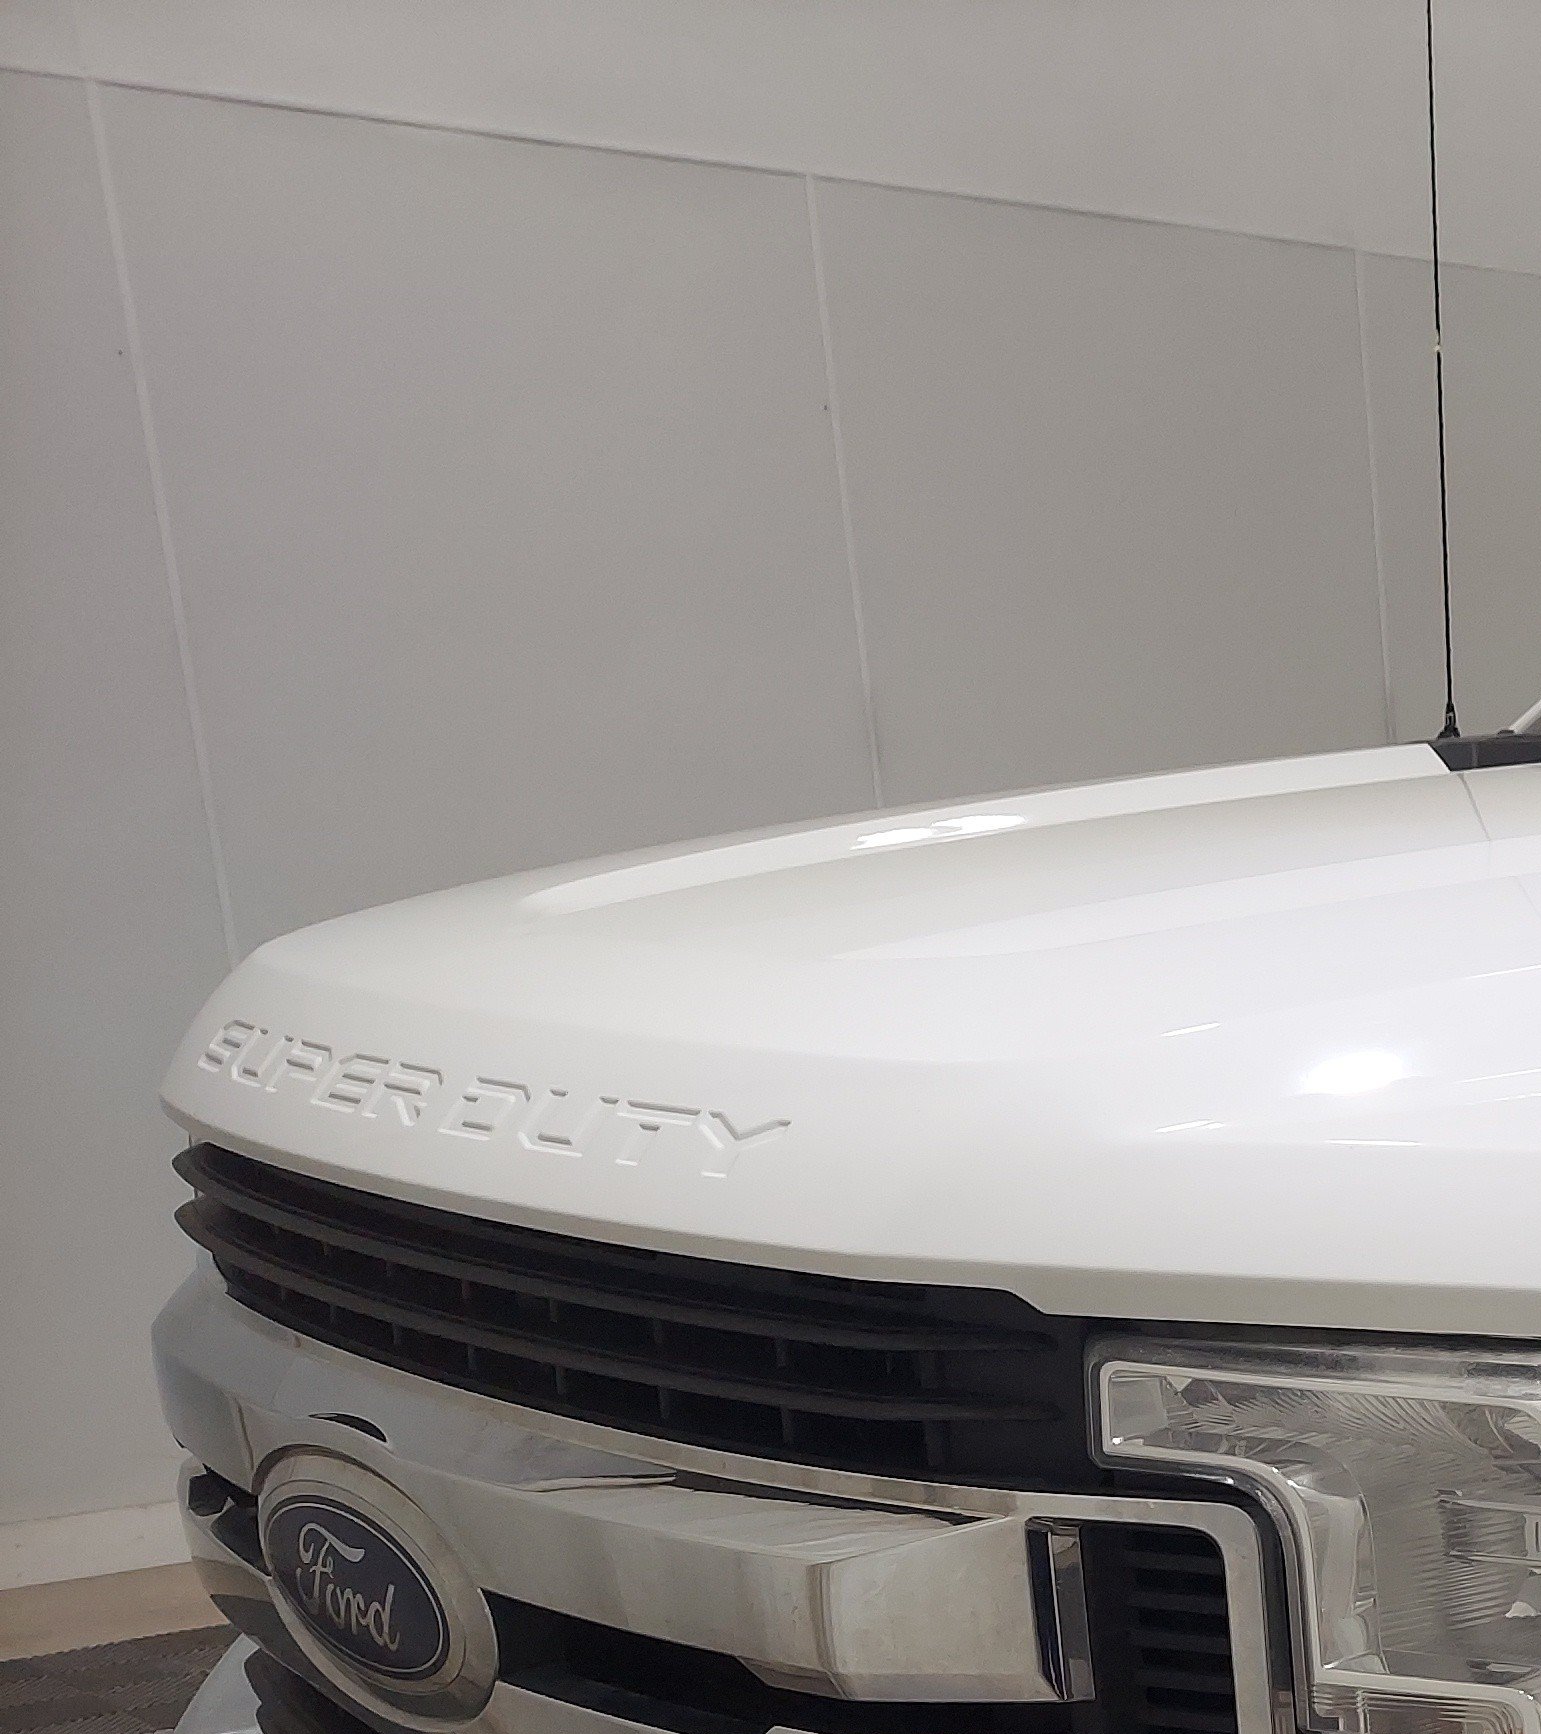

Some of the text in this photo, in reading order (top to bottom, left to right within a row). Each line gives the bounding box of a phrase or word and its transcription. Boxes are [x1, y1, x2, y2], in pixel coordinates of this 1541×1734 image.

[197, 1018, 792, 1179] SUPER DUTY
[296, 1521, 401, 1651] Ford
